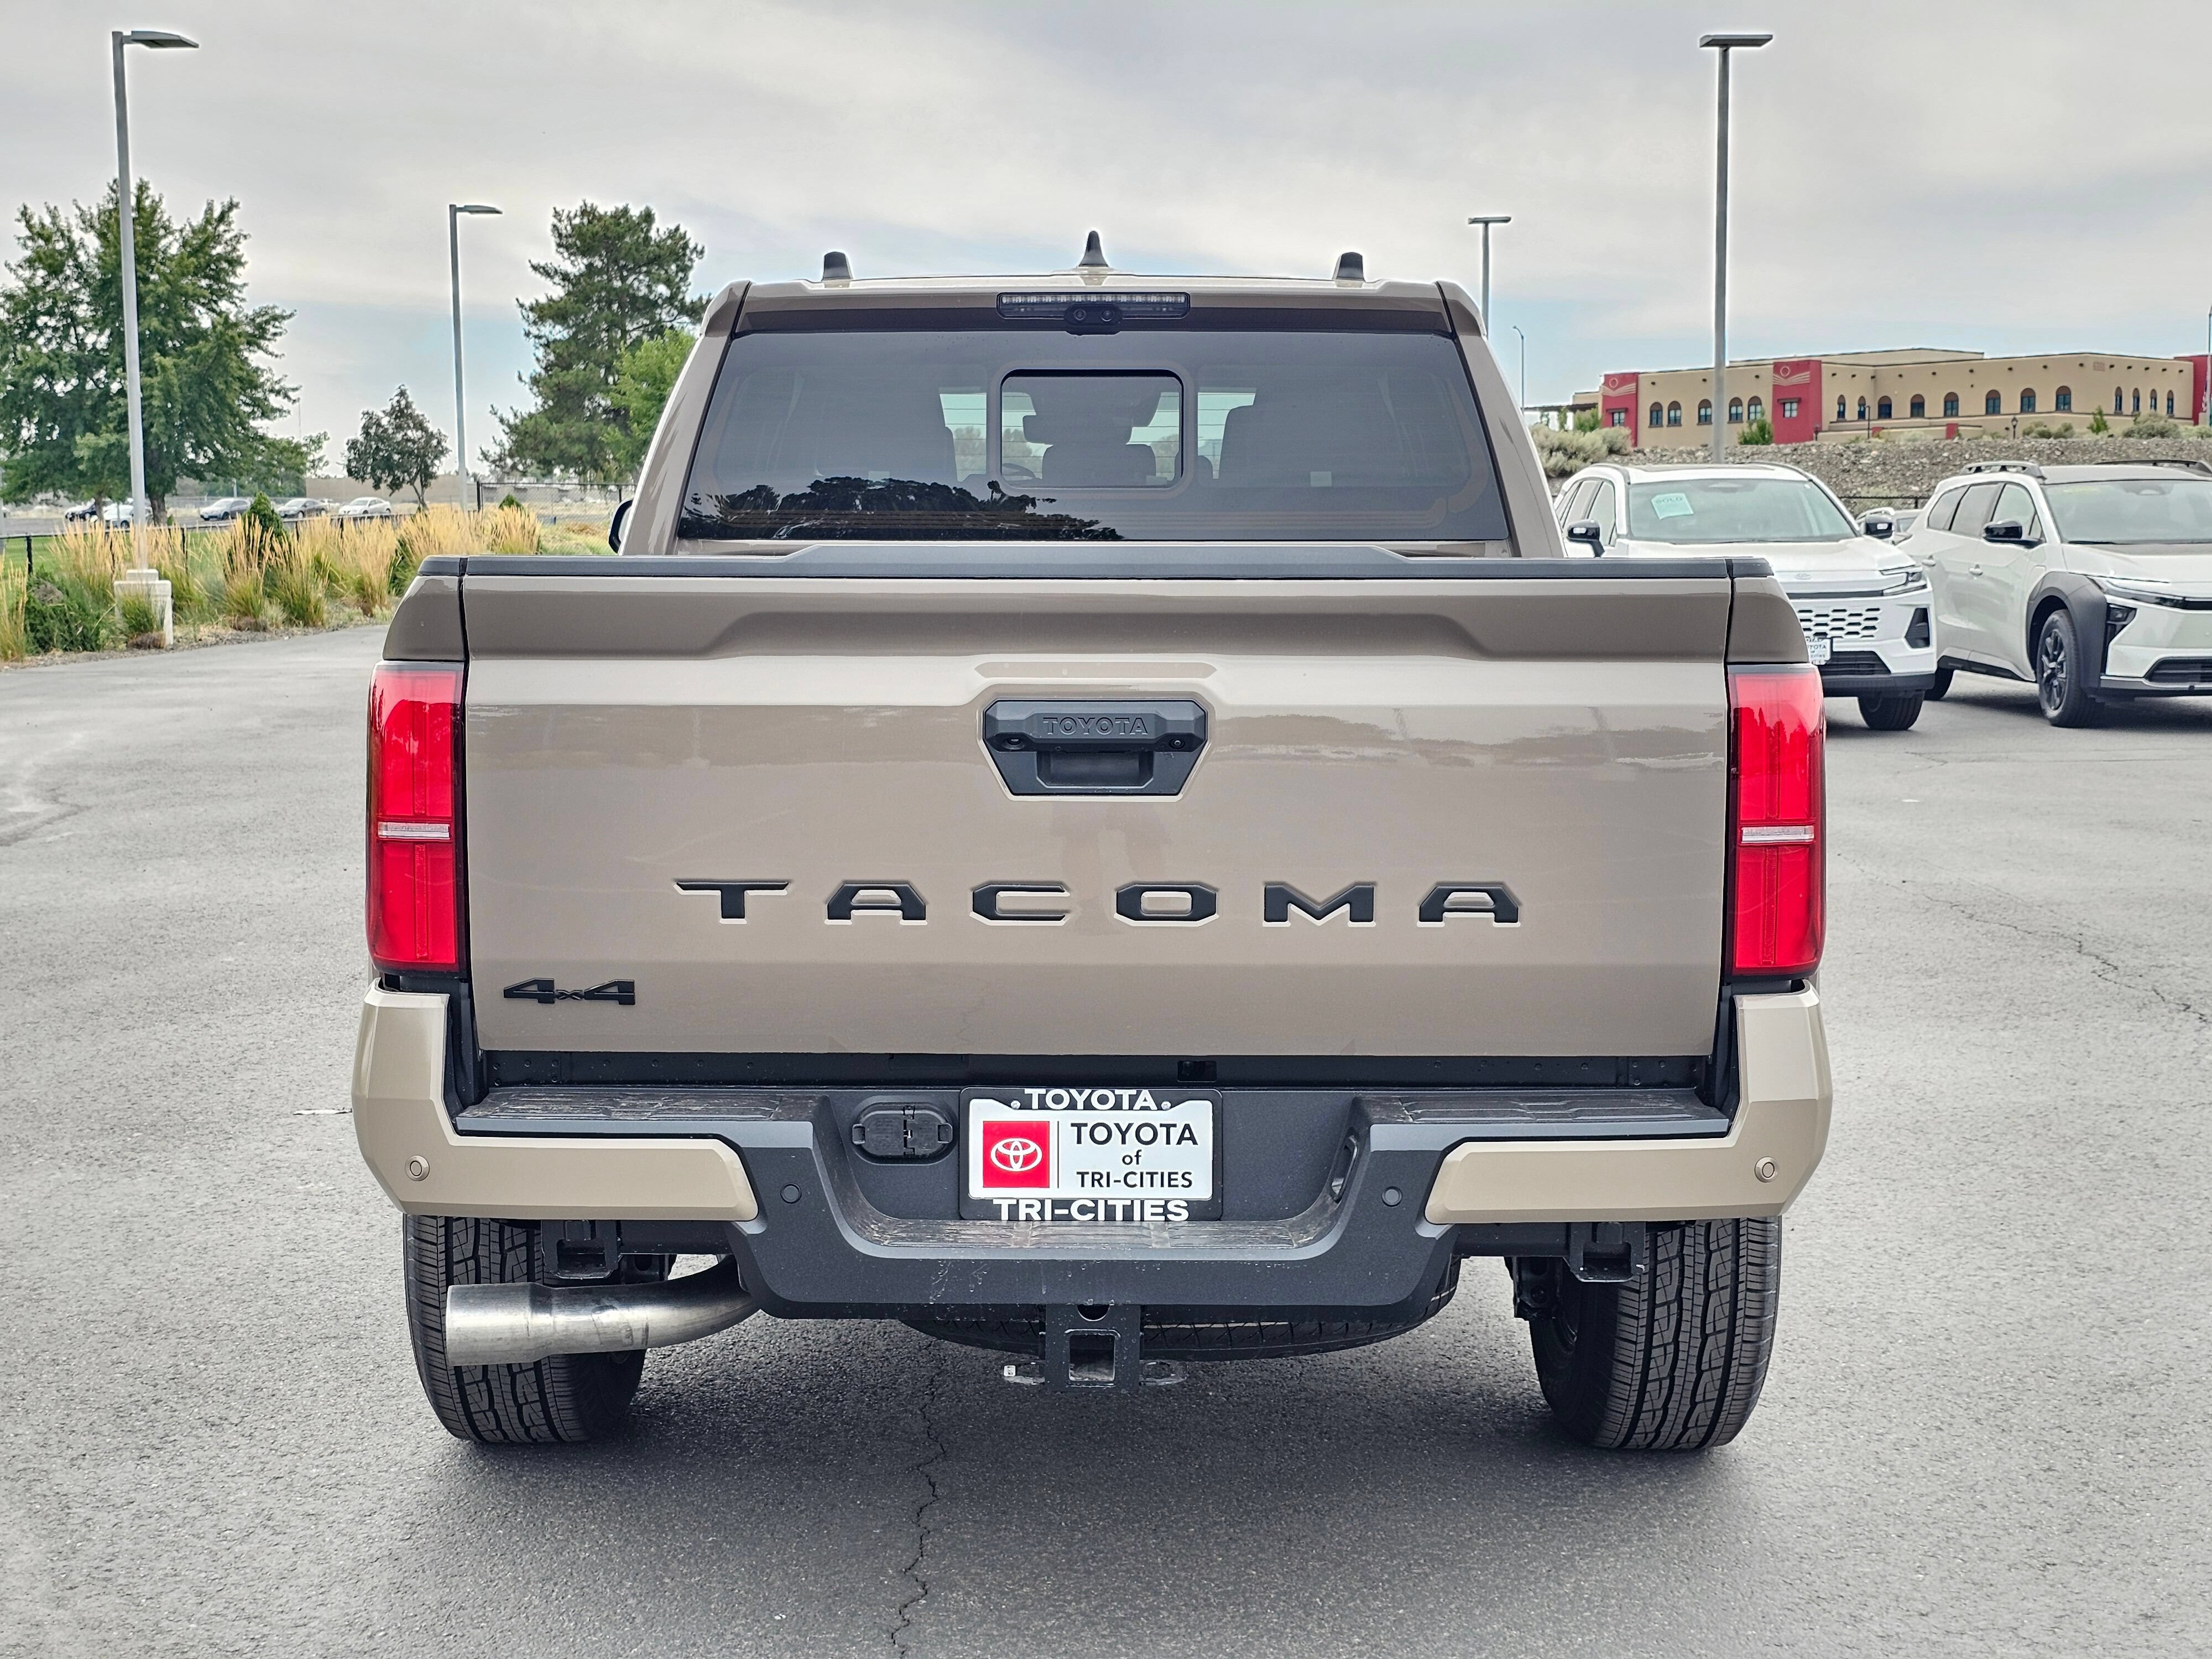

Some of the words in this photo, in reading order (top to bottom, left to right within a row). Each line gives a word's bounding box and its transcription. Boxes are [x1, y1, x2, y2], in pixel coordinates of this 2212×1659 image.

[1043, 717, 1148, 735] TOYOTA
[674, 880, 1521, 927] TACOMA
[1024, 1088, 1159, 1110] TOYOTA
[1071, 1123, 1199, 1146] TOYOTA
[1121, 1149, 1142, 1166] of
[1076, 1171, 1193, 1188] TRI-CITIES
[992, 1199, 1190, 1222] TRI-CITIES
